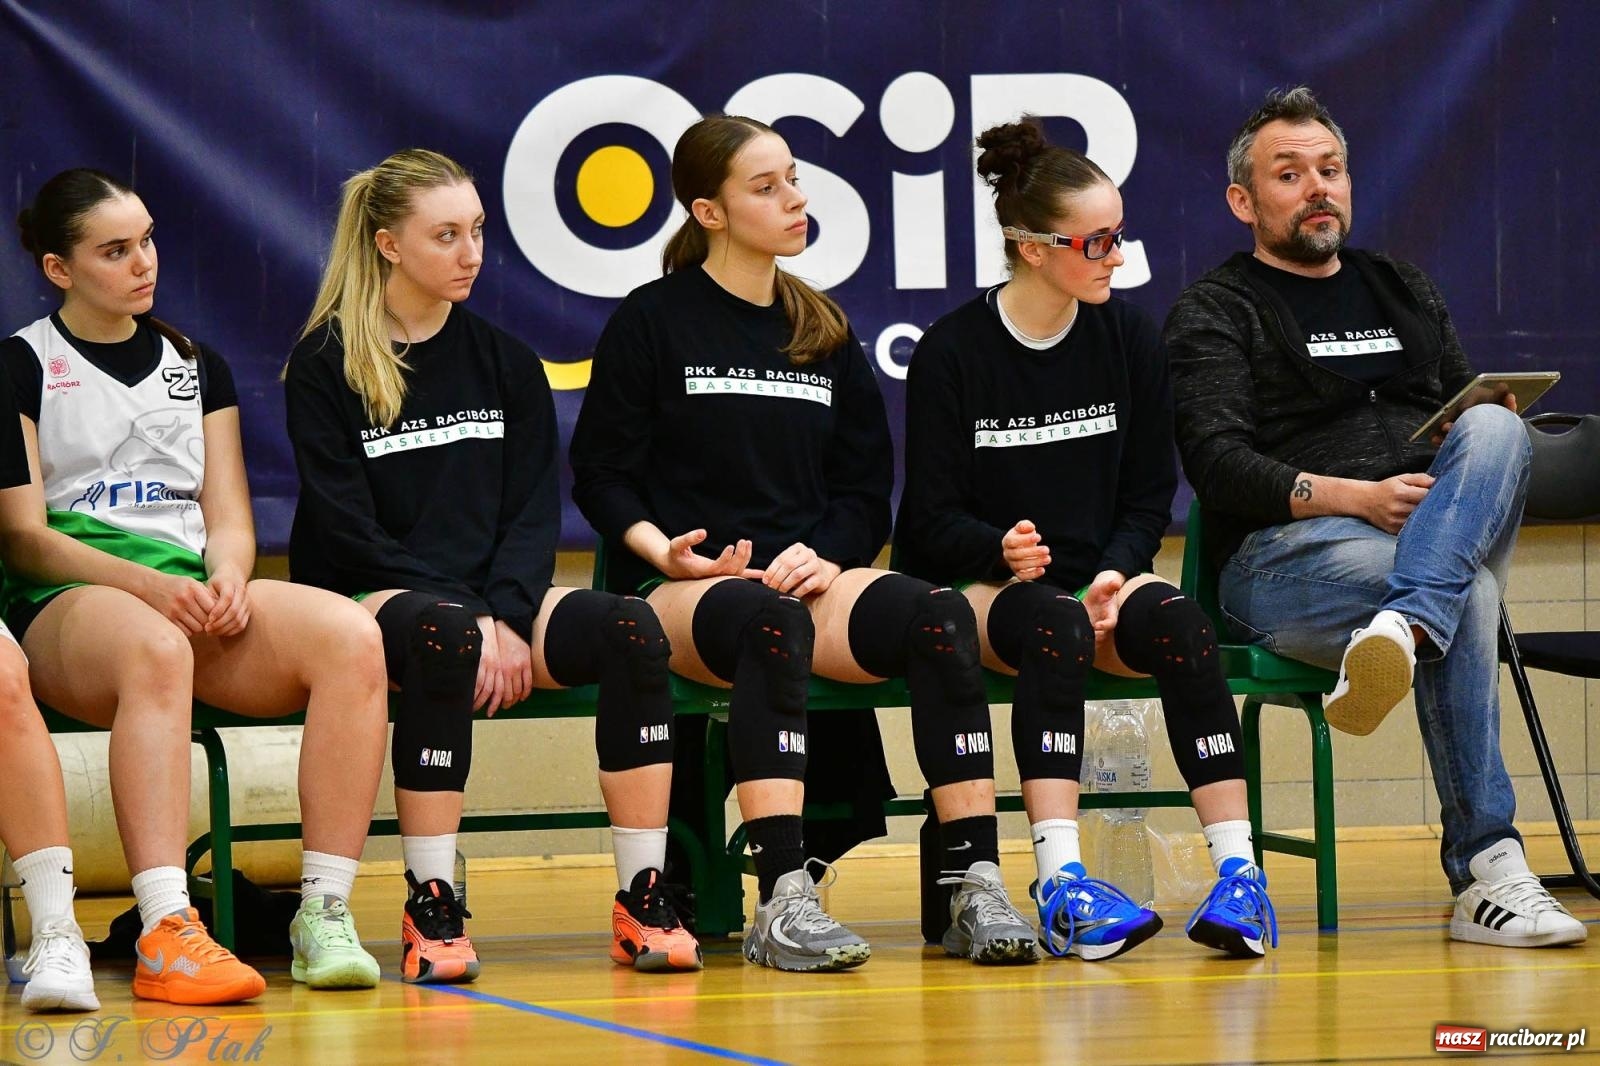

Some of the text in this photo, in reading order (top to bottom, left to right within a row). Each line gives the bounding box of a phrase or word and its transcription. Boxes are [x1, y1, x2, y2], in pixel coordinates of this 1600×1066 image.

[503, 72, 1151, 298] OSiR
[1310, 332, 1337, 342] AZS
[684, 366, 833, 389] RKK AZS RACIBÓRZ
[688, 380, 830, 402] BASKETBALL
[360, 408, 504, 441] RKK AZS RACIBÓRZ
[975, 402, 1117, 431] RKK AZS RACIBÓRZ
[976, 419, 1115, 444] BASKETBALL
[650, 723, 670, 742] NBA
[789, 732, 806, 755] NBA
[967, 731, 991, 754] NBA
[1054, 732, 1077, 755] NBA
[1206, 732, 1236, 756] NBA
[430, 749, 452, 768] NBA
